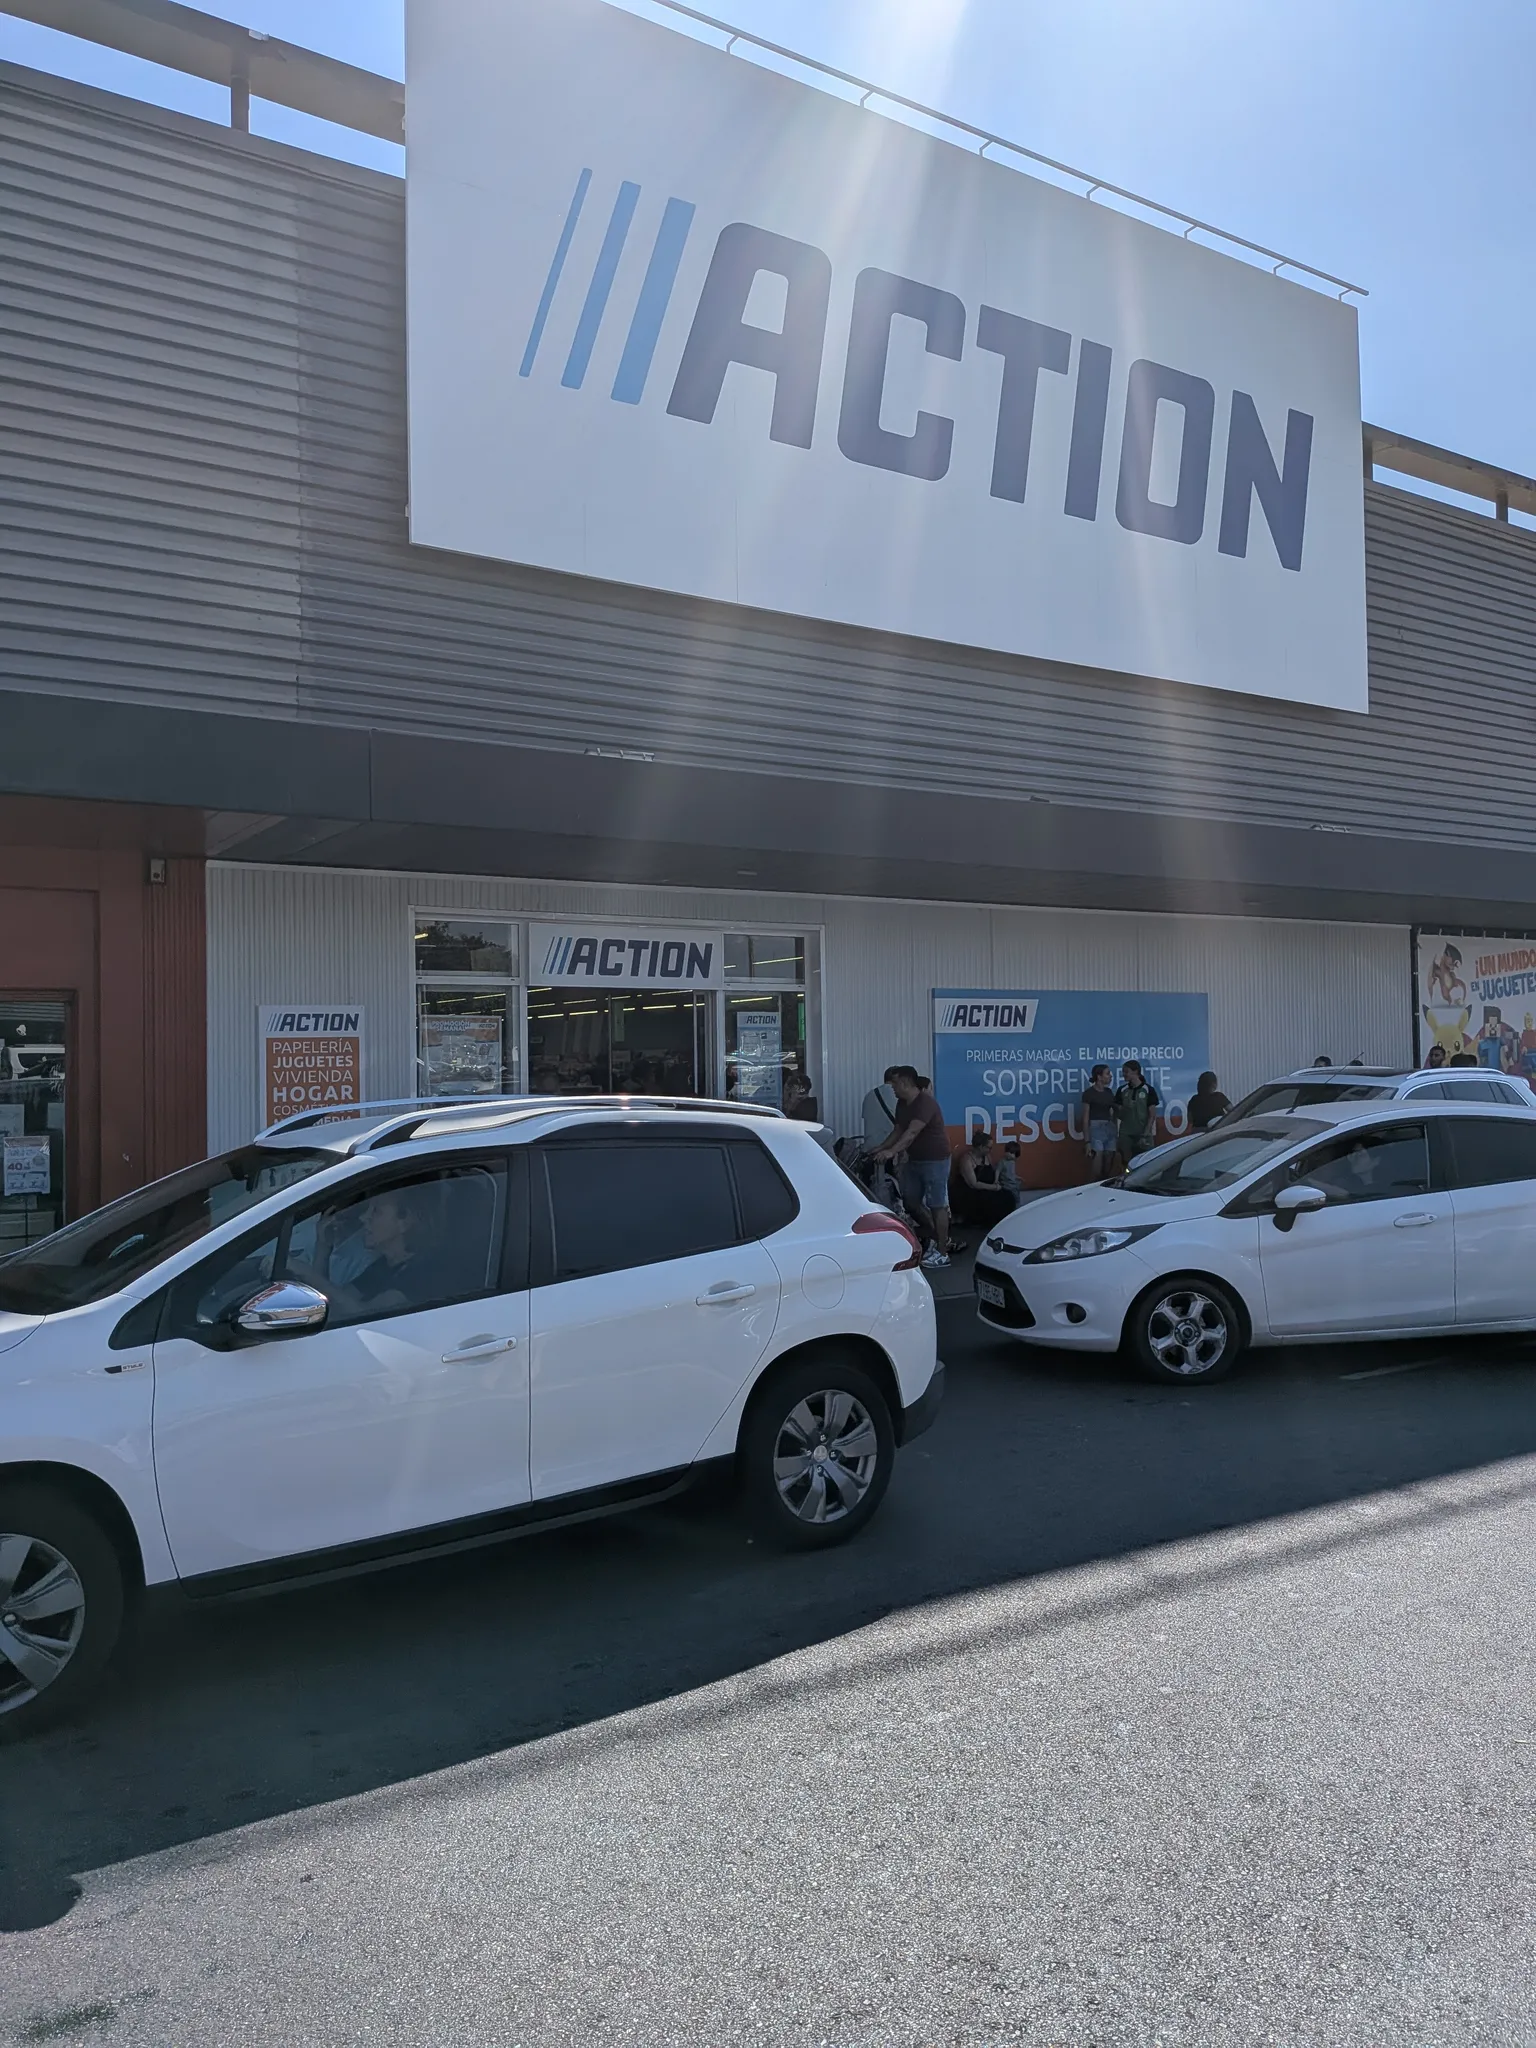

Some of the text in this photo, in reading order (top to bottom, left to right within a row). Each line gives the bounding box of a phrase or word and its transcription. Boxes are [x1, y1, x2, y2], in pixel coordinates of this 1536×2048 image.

[666, 222, 1314, 572] ACTION
[567, 937, 713, 979] ACTION
[1479, 972, 1536, 1001] JUGUETE
[279, 1013, 360, 1032] ACTION
[746, 1015, 777, 1025] ACTION
[953, 1004, 1027, 1028] ACTION
[272, 1038, 353, 1054] PAPELERÍA
[966, 1046, 1184, 1062] PRIMERAS MARCAS EL MEJOR PRECIO
[273, 1055, 354, 1069] JUGUETES
[273, 1070, 354, 1083] VIVIENDA
[273, 1084, 354, 1102] HOGAR
[964, 1099, 1188, 1145] DESCUO
